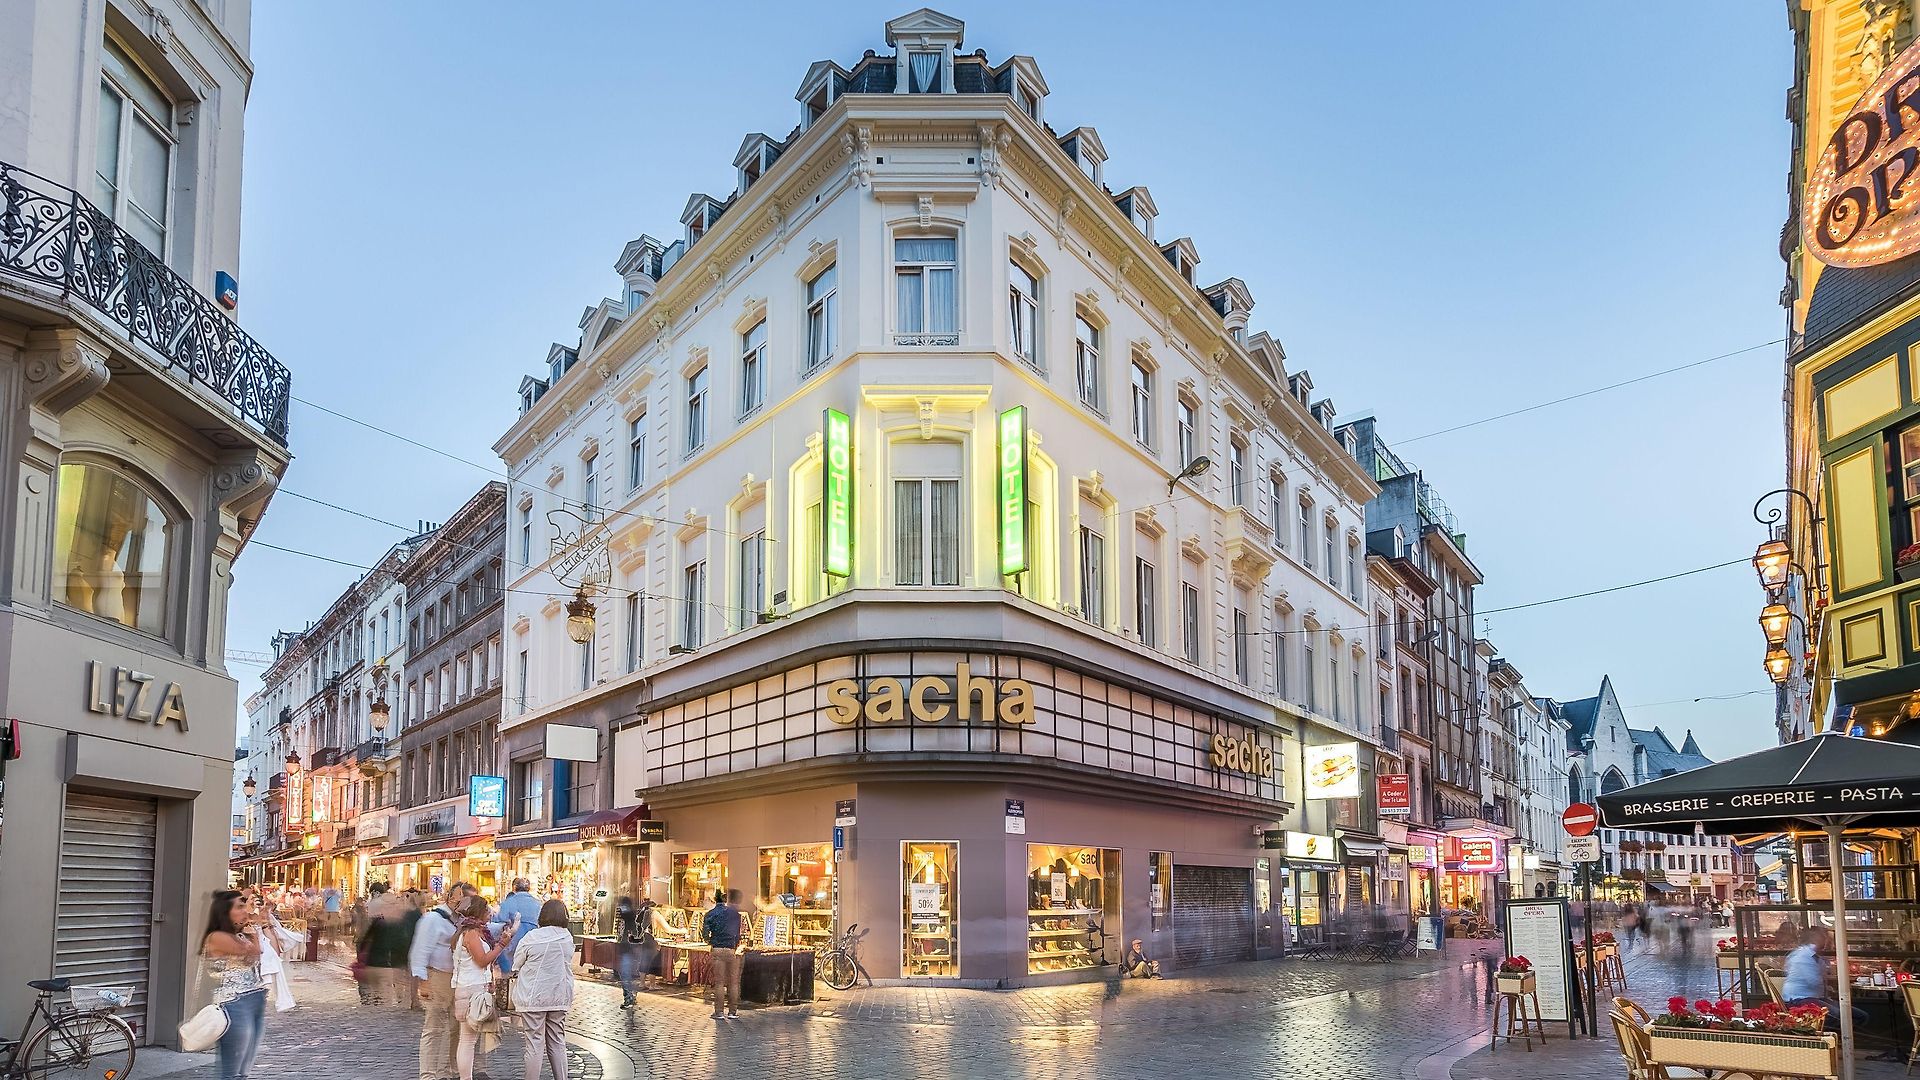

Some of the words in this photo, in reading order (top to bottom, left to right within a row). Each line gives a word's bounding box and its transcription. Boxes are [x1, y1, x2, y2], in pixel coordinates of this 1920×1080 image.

[830, 416, 848, 553] HOTEL
[1002, 415, 1019, 550] HOTEL
[88, 660, 189, 732] LIZA
[825, 662, 1036, 724] sacha
[1211, 733, 1273, 778] sacha
[1624, 797, 1709, 816] BRASSERIE
[1731, 790, 1816, 808] CREPERIE
[1840, 786, 1904, 802] PASTA
[580, 825, 598, 839] HOTEL
[600, 823, 621, 836] OPERA
[1462, 842, 1491, 850] Galerie
[692, 854, 715, 868] sacha
[918, 899, 933, 909] 50%
